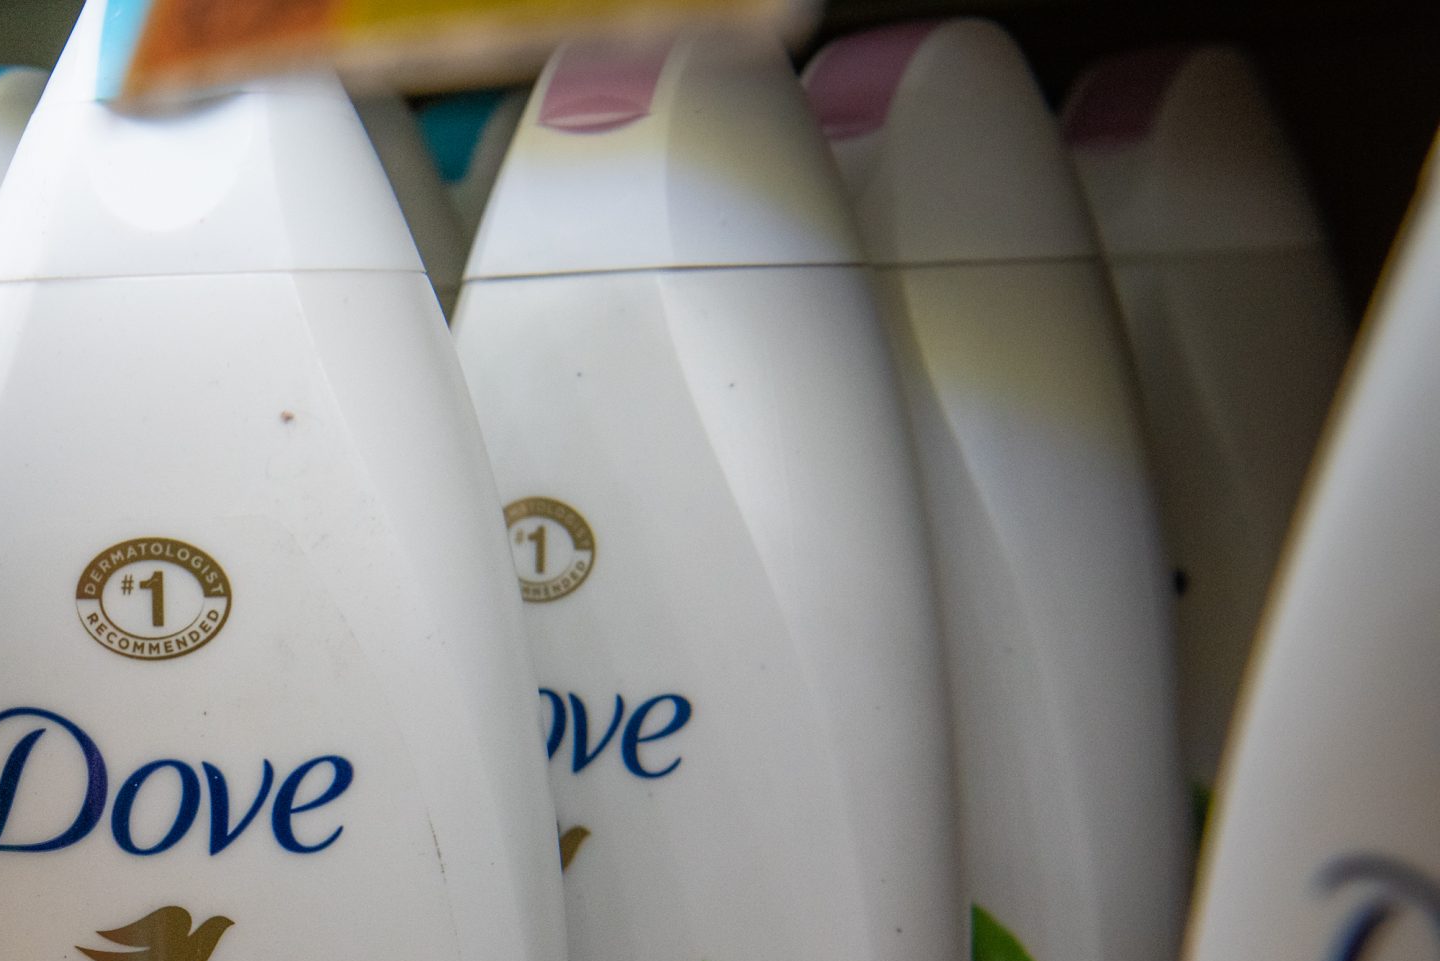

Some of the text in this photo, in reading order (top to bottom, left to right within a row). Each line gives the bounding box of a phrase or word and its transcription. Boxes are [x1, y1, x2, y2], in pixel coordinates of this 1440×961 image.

[84, 542, 224, 596] DERMATOLOGIST
[121, 570, 164, 627] #1
[86, 609, 219, 655] RECOMMENDED
[538, 687, 693, 780] ve
